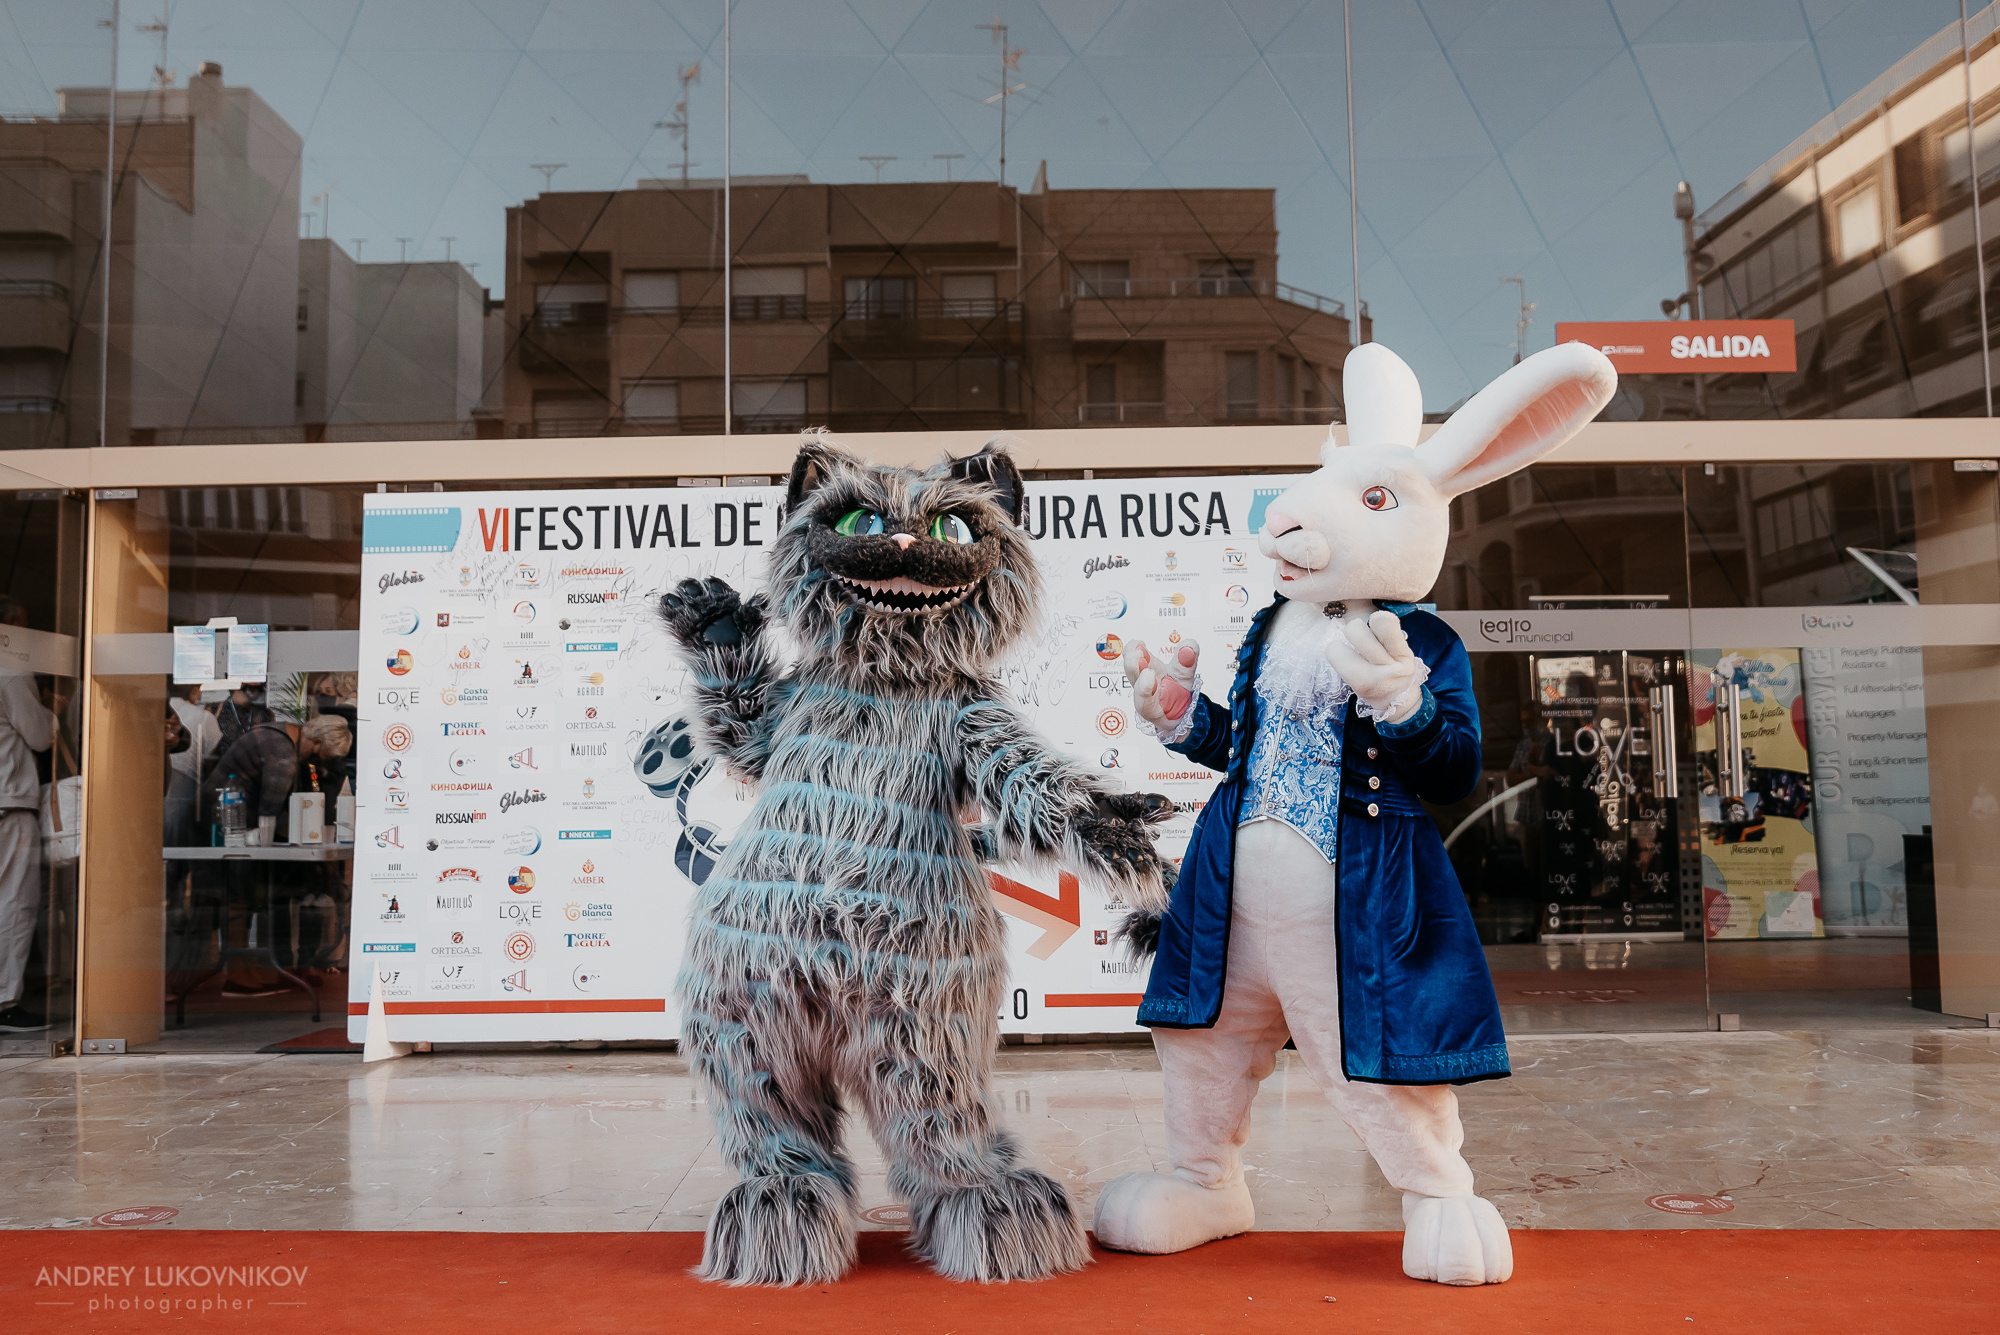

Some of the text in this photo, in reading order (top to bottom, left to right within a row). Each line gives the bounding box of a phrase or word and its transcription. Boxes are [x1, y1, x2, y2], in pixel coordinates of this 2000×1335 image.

[1670, 335, 1770, 359] SALIDA
[1120, 491, 1231, 538] RUSA
[478, 502, 763, 551] VI FESTIVAL DE
[561, 567, 624, 576] КИНОАФИША
[1515, 631, 1573, 643] municipal
[448, 661, 480, 669] AMBER
[1542, 710, 1593, 718] HAIRDRESSERS
[570, 742, 607, 756] NAUTILUS
[1555, 727, 1648, 765] LOVE
[1148, 771, 1213, 780] КИНОАФИША
[431, 783, 493, 791] КИНОАФИША
[571, 876, 605, 884] AMBER
[436, 895, 473, 909] NAUTILUS
[431, 946, 482, 955] ORTEGA.SL
